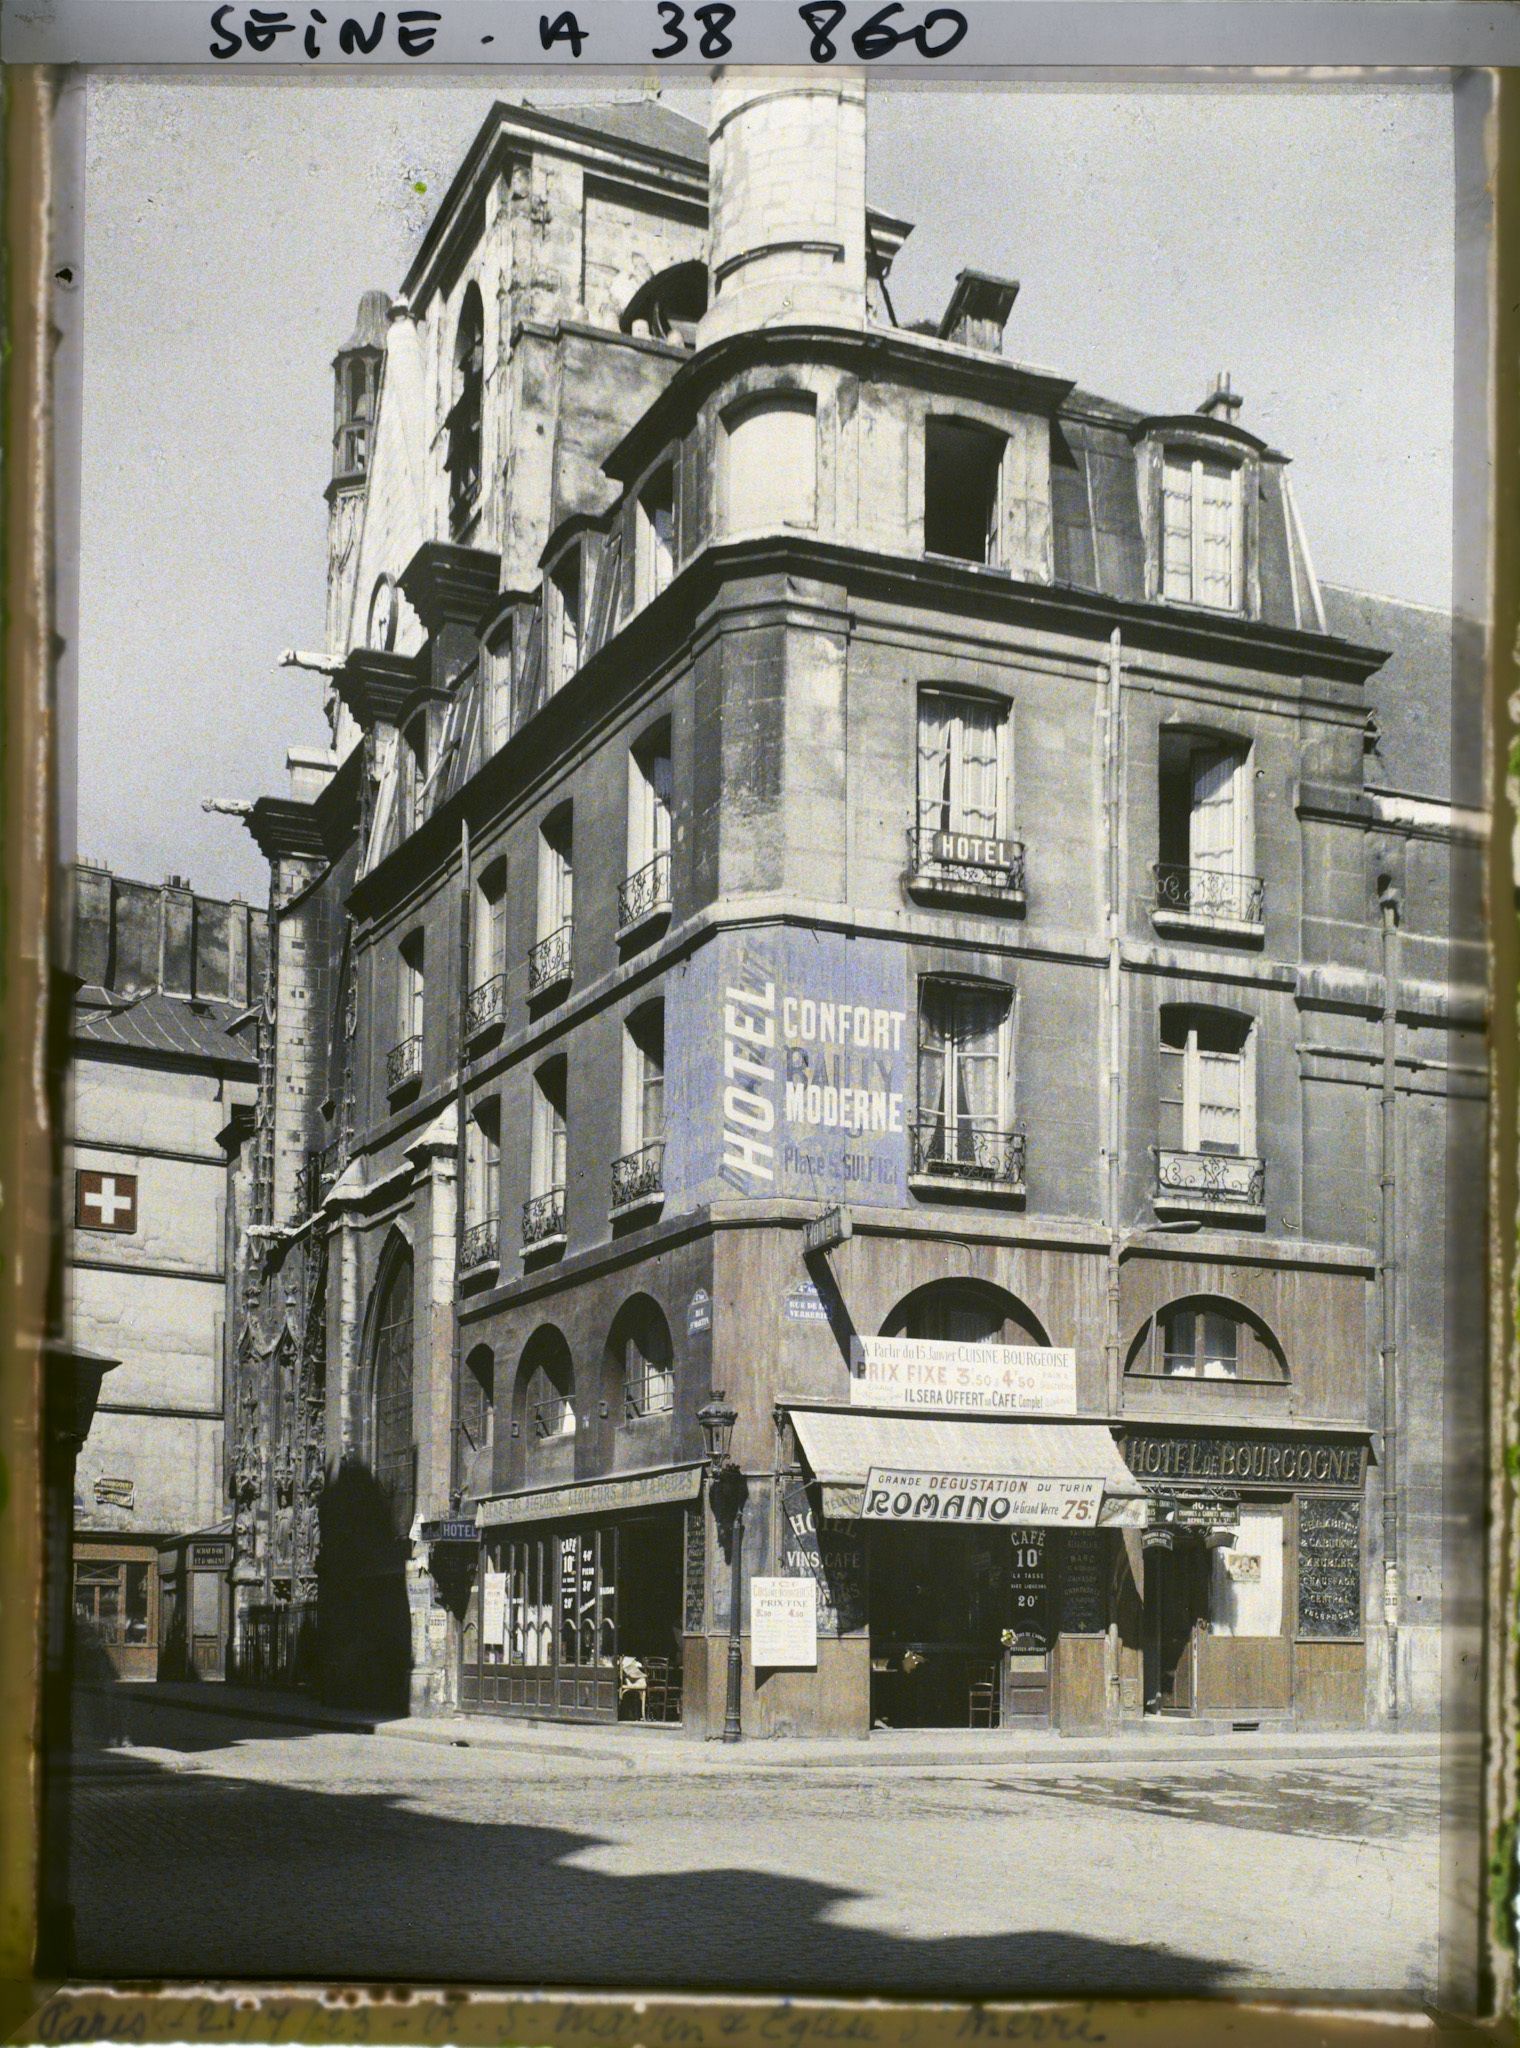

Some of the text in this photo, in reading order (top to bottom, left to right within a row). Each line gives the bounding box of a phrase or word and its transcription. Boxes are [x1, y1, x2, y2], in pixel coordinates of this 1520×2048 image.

[540, 11, 588, 58] A
[652, 4, 735, 58] 38
[801, 2, 968, 63] 860
[942, 834, 1011, 867] HOTEL
[782, 996, 906, 1051] CONFORT
[724, 982, 775, 1181] HOTEL
[785, 1080, 904, 1133] MODERNE
[873, 1342, 902, 1358] Partir
[903, 1344, 915, 1359] du
[958, 1346, 999, 1365] CUISINE
[1003, 1349, 1069, 1369] BOURGEOISE
[857, 1361, 900, 1381] PRIX
[907, 1364, 947, 1386] FIXE
[945, 1389, 985, 1407] OFFERT
[992, 1390, 1017, 1409] CAFE
[1131, 1440, 1358, 1481] HOTEL DE BOURGOGNE
[878, 1475, 1093, 1493] GRANDE DEGUSTATION DU TURIN
[864, 1489, 1011, 1522] ROMANO
[442, 1523, 478, 1538] HOTEL
[1010, 1529, 1047, 1548] CAFÉ
[760, 1599, 783, 1607] PRIX
[38, 2000, 147, 2042] Paris
